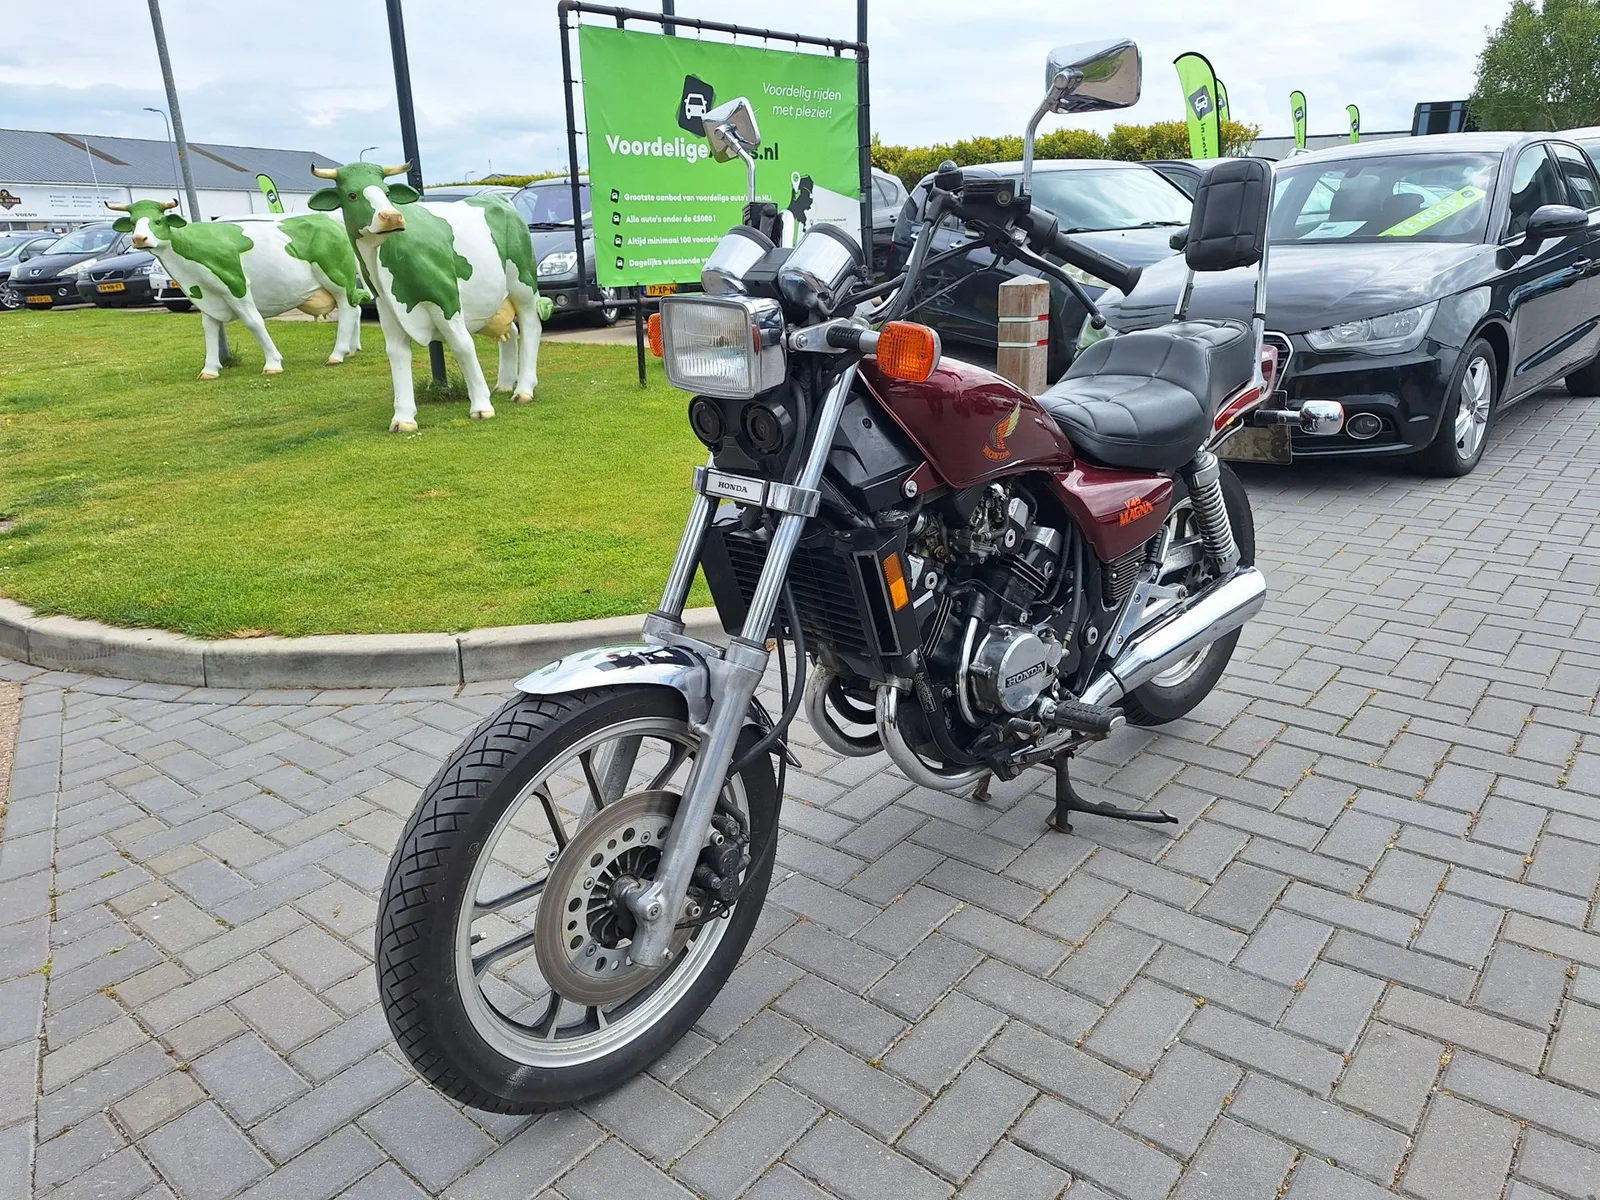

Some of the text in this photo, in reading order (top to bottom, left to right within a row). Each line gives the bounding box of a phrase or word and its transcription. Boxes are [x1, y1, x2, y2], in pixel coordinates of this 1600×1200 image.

[762, 82, 842, 103] Voordelig rijden
[772, 104, 833, 120] met plezier!
[605, 134, 779, 164] Voordeliges.nl
[623, 193, 655, 202] Grootste
[656, 193, 682, 202] aanbod
[696, 194, 730, 203] voordelige
[626, 215, 640, 223] Alle
[640, 215, 662, 223] auto's
[663, 215, 683, 223] onder
[683, 215, 692, 223] de
[1394, 198, 1458, 234] TE KOOP
[627, 238, 647, 246] Altijd
[648, 237, 679, 245] minimaal
[680, 236, 692, 244] 100
[628, 259, 662, 269] Dagelijks
[663, 257, 700, 266] wisselende
[983, 444, 1011, 461] HONDA
[717, 481, 748, 494] HONDA
[1123, 495, 1142, 509] V45
[1119, 501, 1154, 527] MAGNA
[1007, 663, 1044, 687] HONDA
